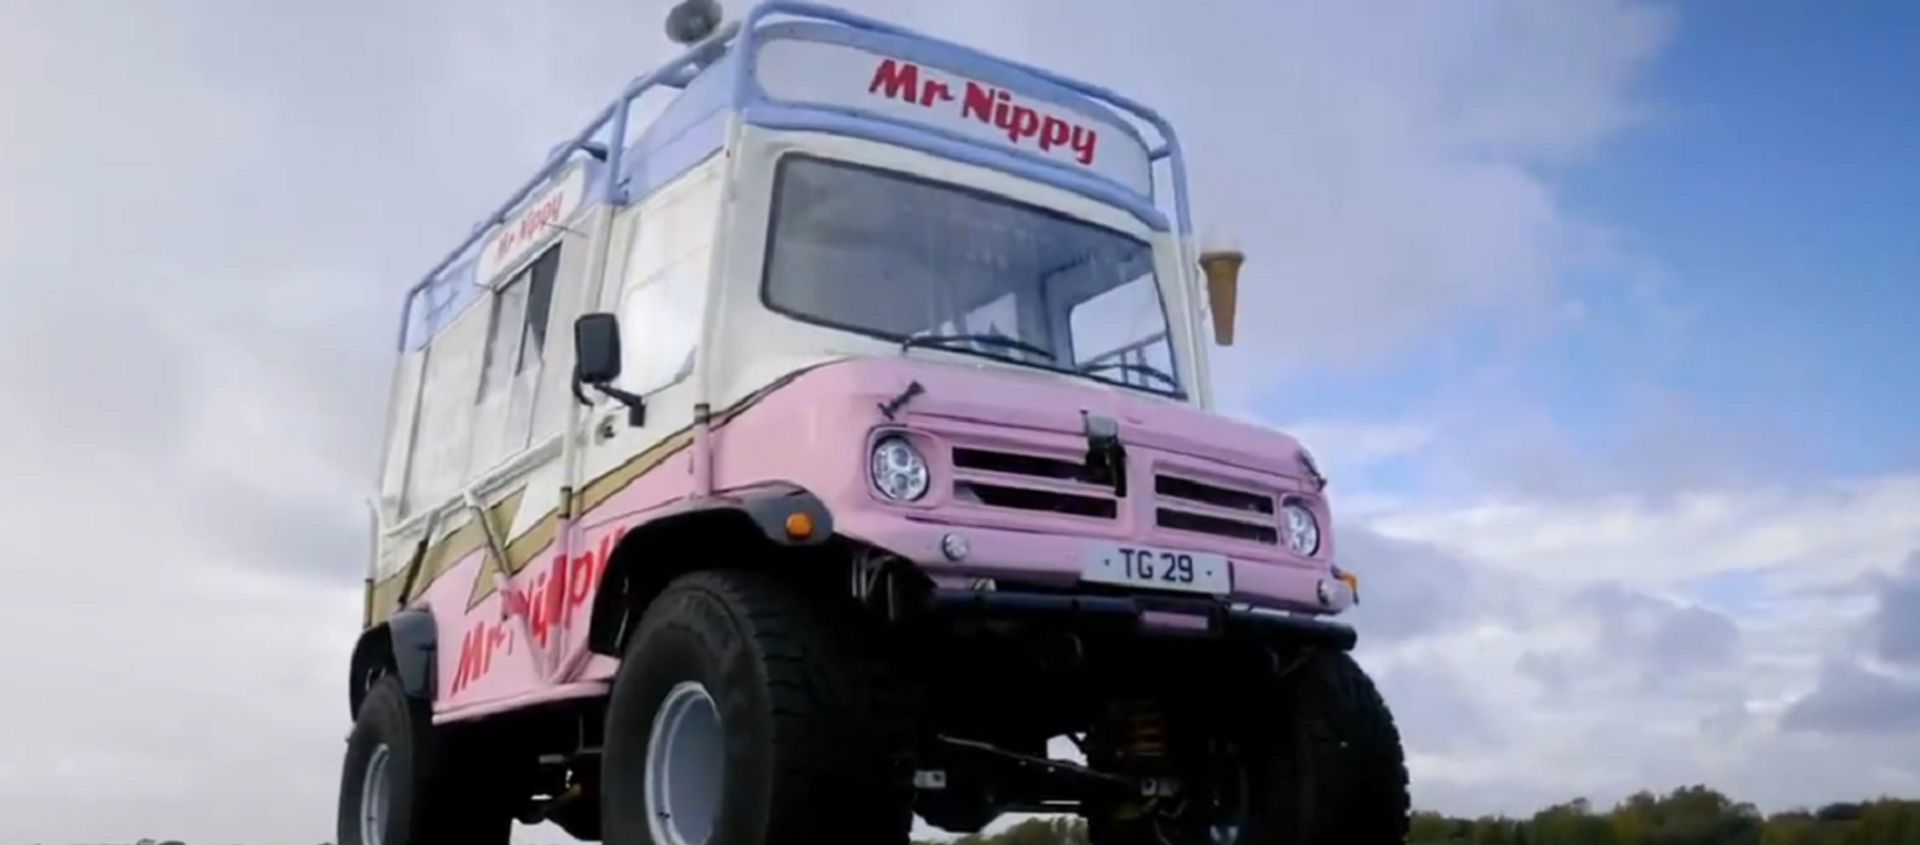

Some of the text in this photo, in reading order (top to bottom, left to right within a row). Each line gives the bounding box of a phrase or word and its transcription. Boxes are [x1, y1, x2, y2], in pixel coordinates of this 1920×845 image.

[868, 58, 1097, 166] Mr Nippy
[496, 191, 563, 262] Mr Nippy
[1118, 548, 1194, 583] TG 29
[450, 620, 506, 697] Mr
